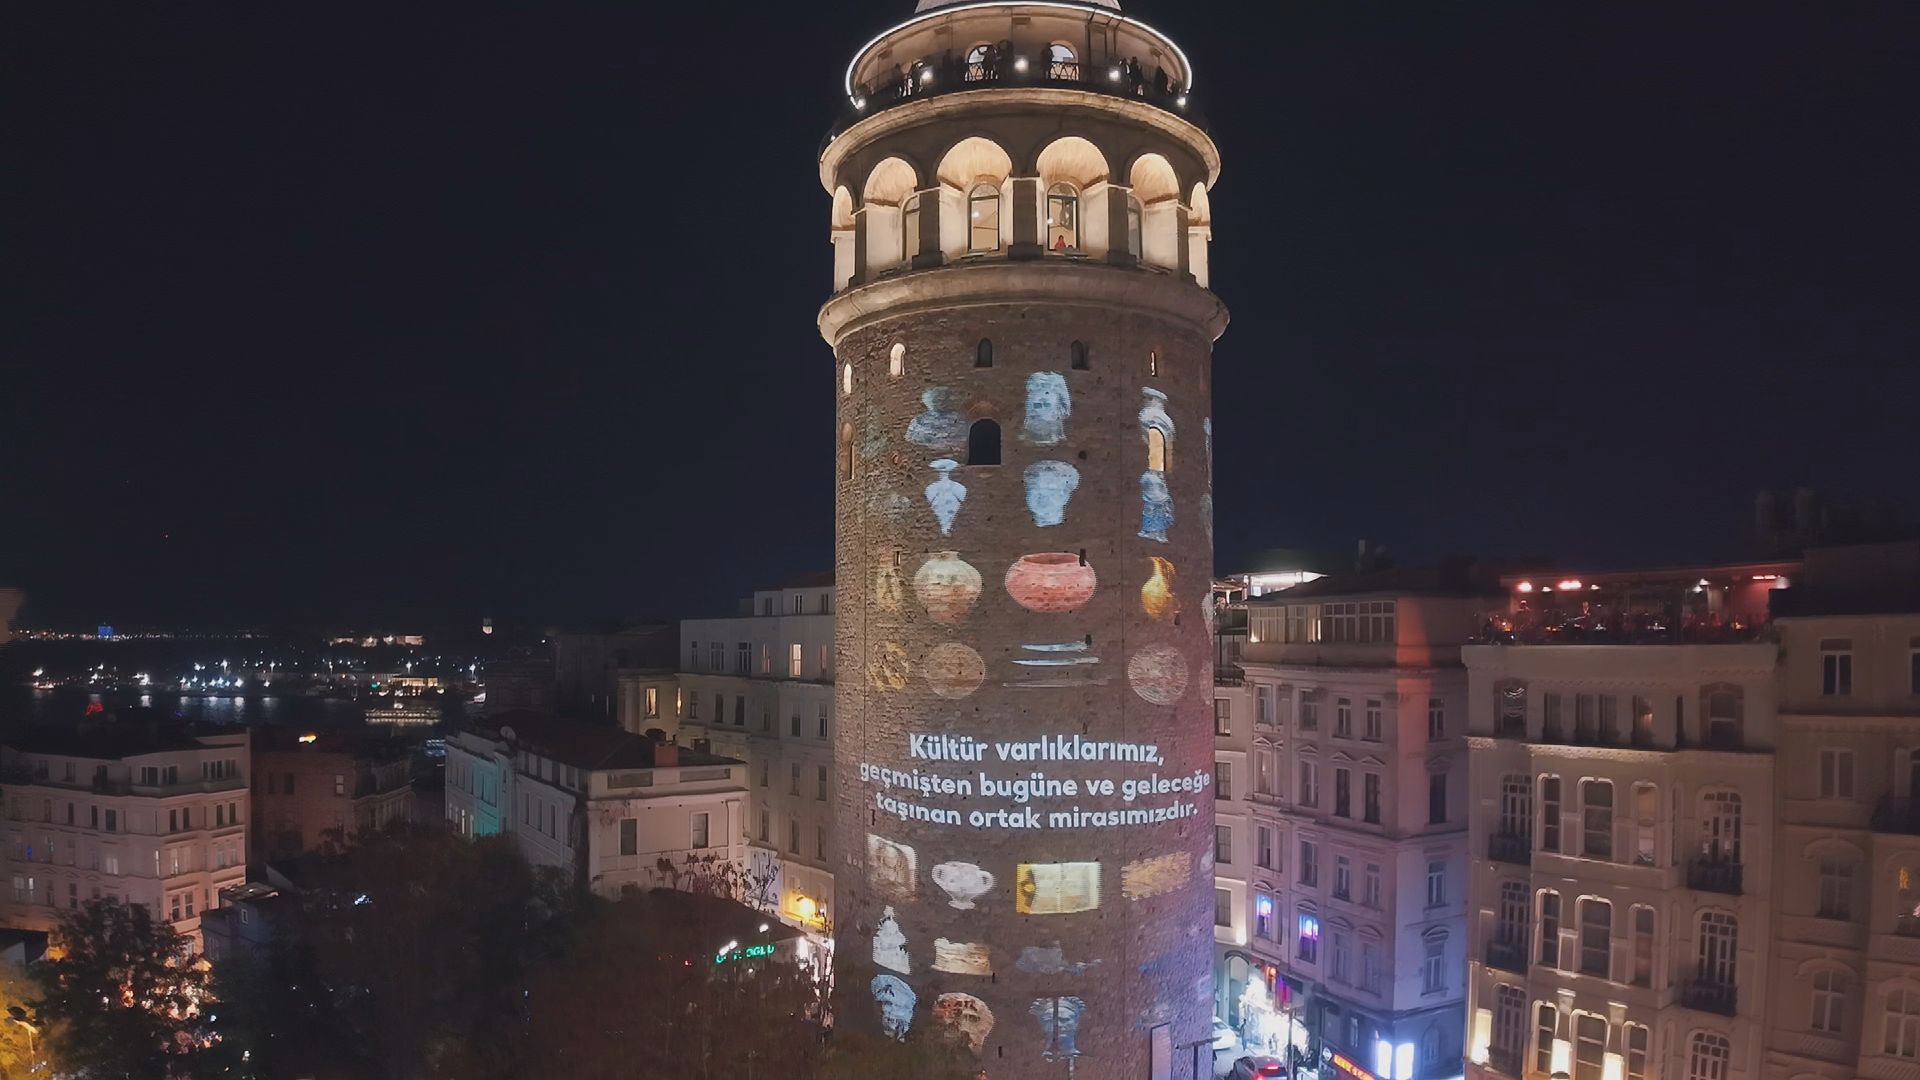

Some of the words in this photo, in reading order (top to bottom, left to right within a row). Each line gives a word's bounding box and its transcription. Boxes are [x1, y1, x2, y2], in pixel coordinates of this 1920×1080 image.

[909, 734, 988, 761] Kültür
[995, 735, 1164, 766] varlıklarımız,
[860, 762, 972, 797] geçmişten
[980, 773, 1077, 802] bugüne
[1086, 779, 1114, 796] ve
[1122, 770, 1210, 801] geleceğe
[875, 793, 961, 825] taşınan
[969, 807, 1041, 829] ortak
[1049, 801, 1197, 828] mirasımızdır.
